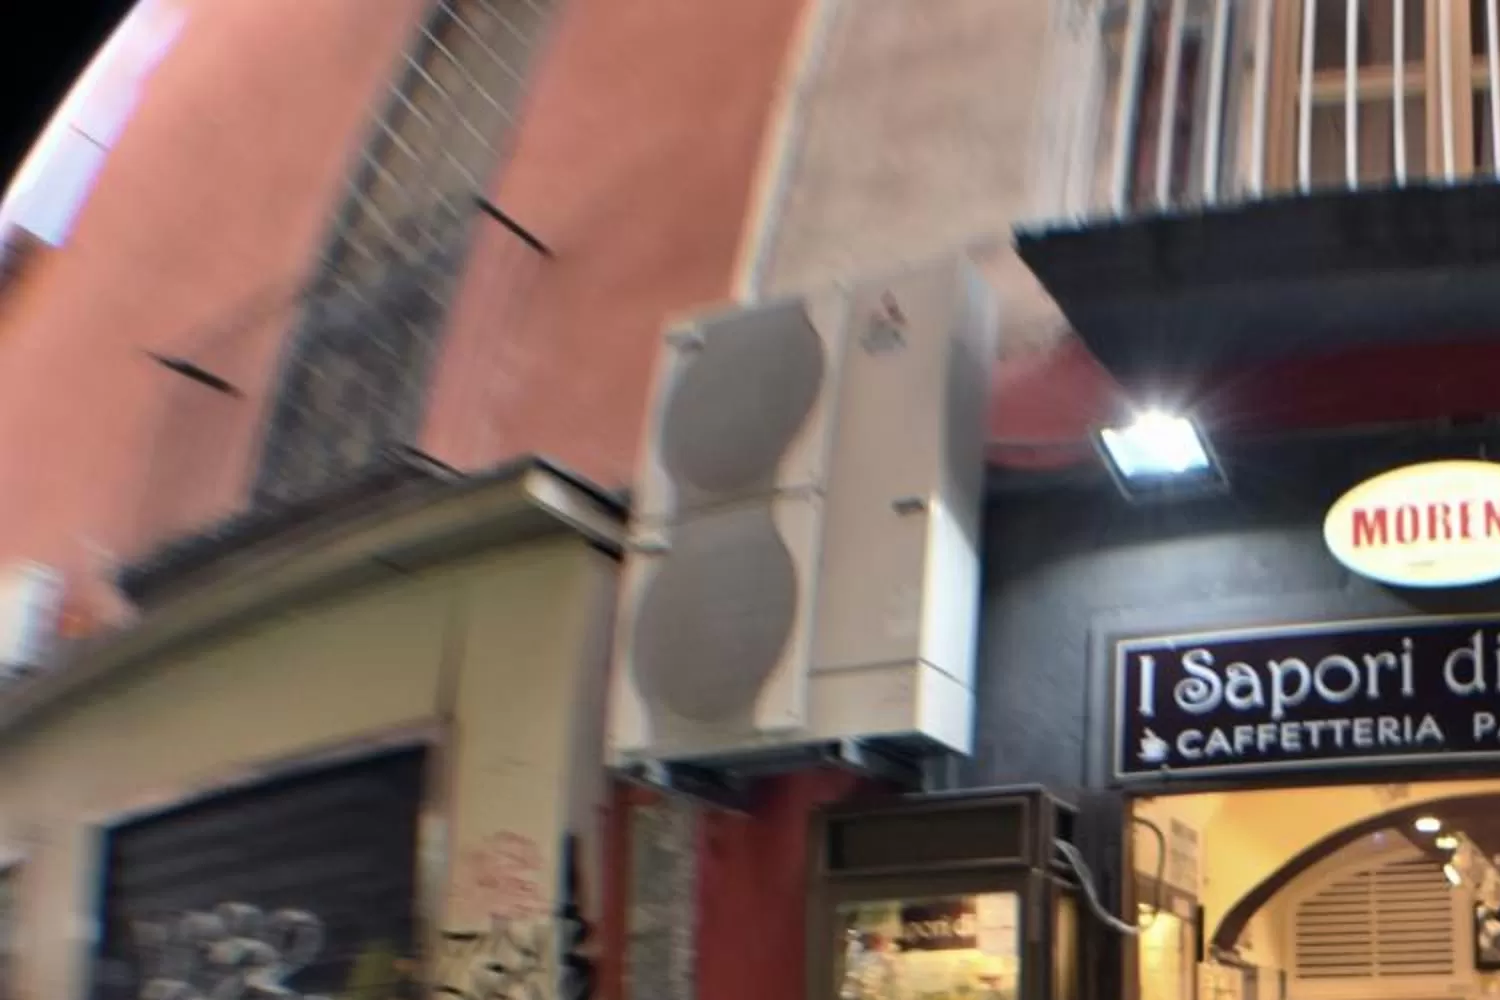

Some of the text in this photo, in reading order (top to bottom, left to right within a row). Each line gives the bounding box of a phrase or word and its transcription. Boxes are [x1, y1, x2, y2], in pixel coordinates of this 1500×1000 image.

[1138, 655, 1155, 716] I
[1174, 638, 1415, 718] Sapori
[1176, 713, 1443, 759] CAFFETTERIA
